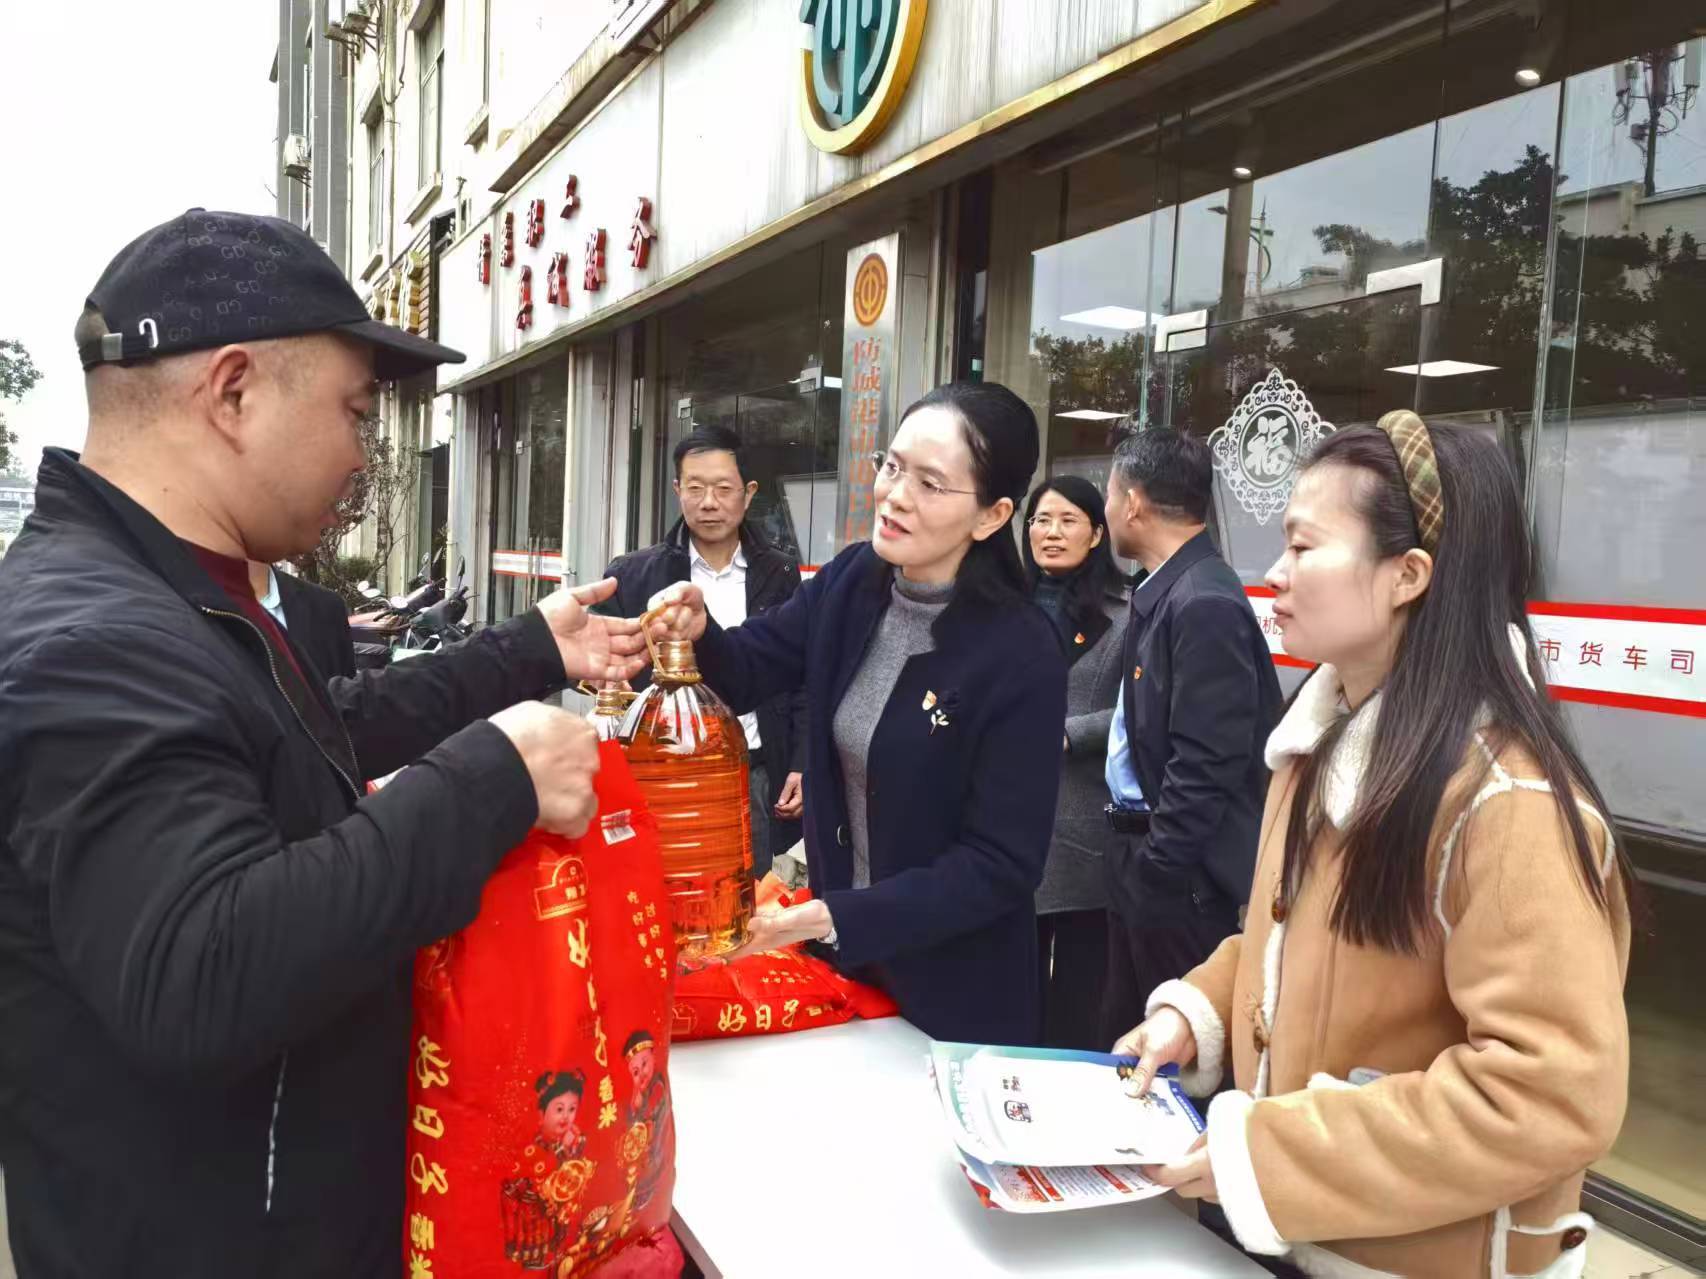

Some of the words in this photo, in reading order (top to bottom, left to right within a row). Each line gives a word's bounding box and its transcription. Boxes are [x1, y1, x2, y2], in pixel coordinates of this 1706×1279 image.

[516, 196, 657, 330] 真情服务
[1245, 415, 1293, 476] 福
